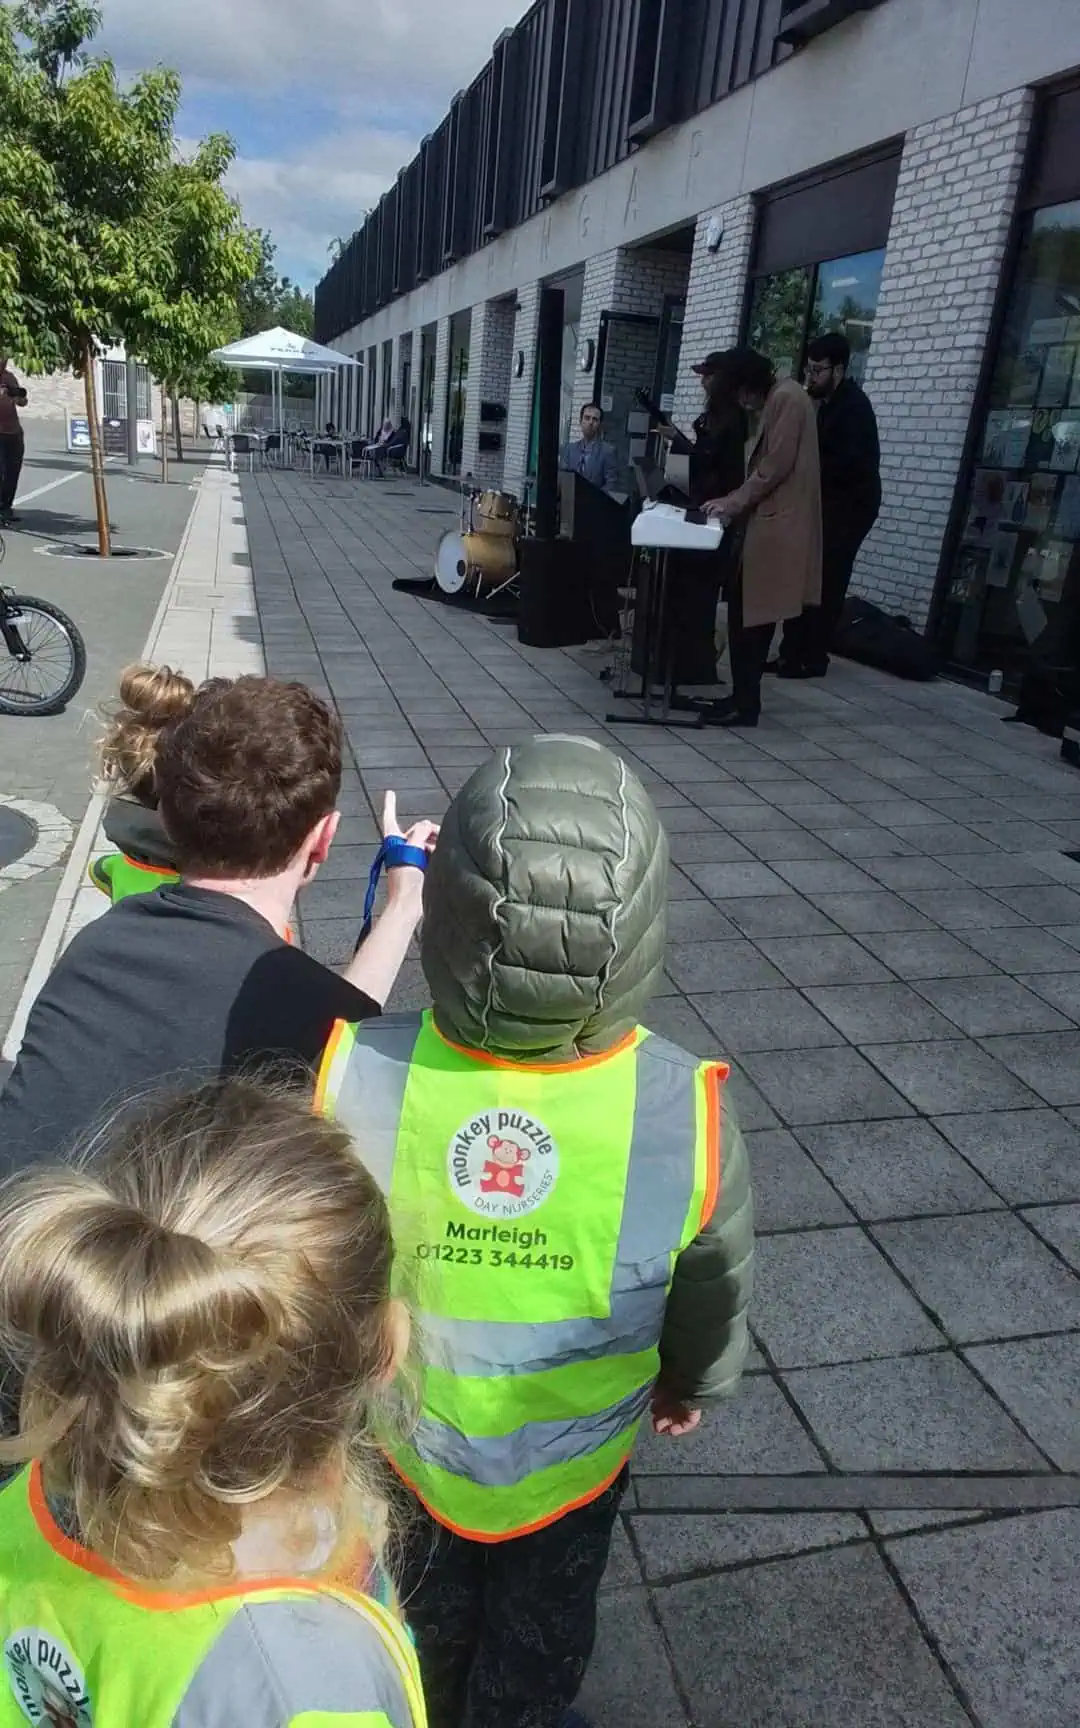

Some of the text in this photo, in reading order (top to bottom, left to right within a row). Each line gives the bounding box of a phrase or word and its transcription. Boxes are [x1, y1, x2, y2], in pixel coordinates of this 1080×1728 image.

[453, 1112, 553, 1187] monkey puzzle
[474, 1170, 553, 1215] DAY NURSERIES
[446, 1221, 547, 1249] Marleigh
[416, 1243, 574, 1271] 01223 344419
